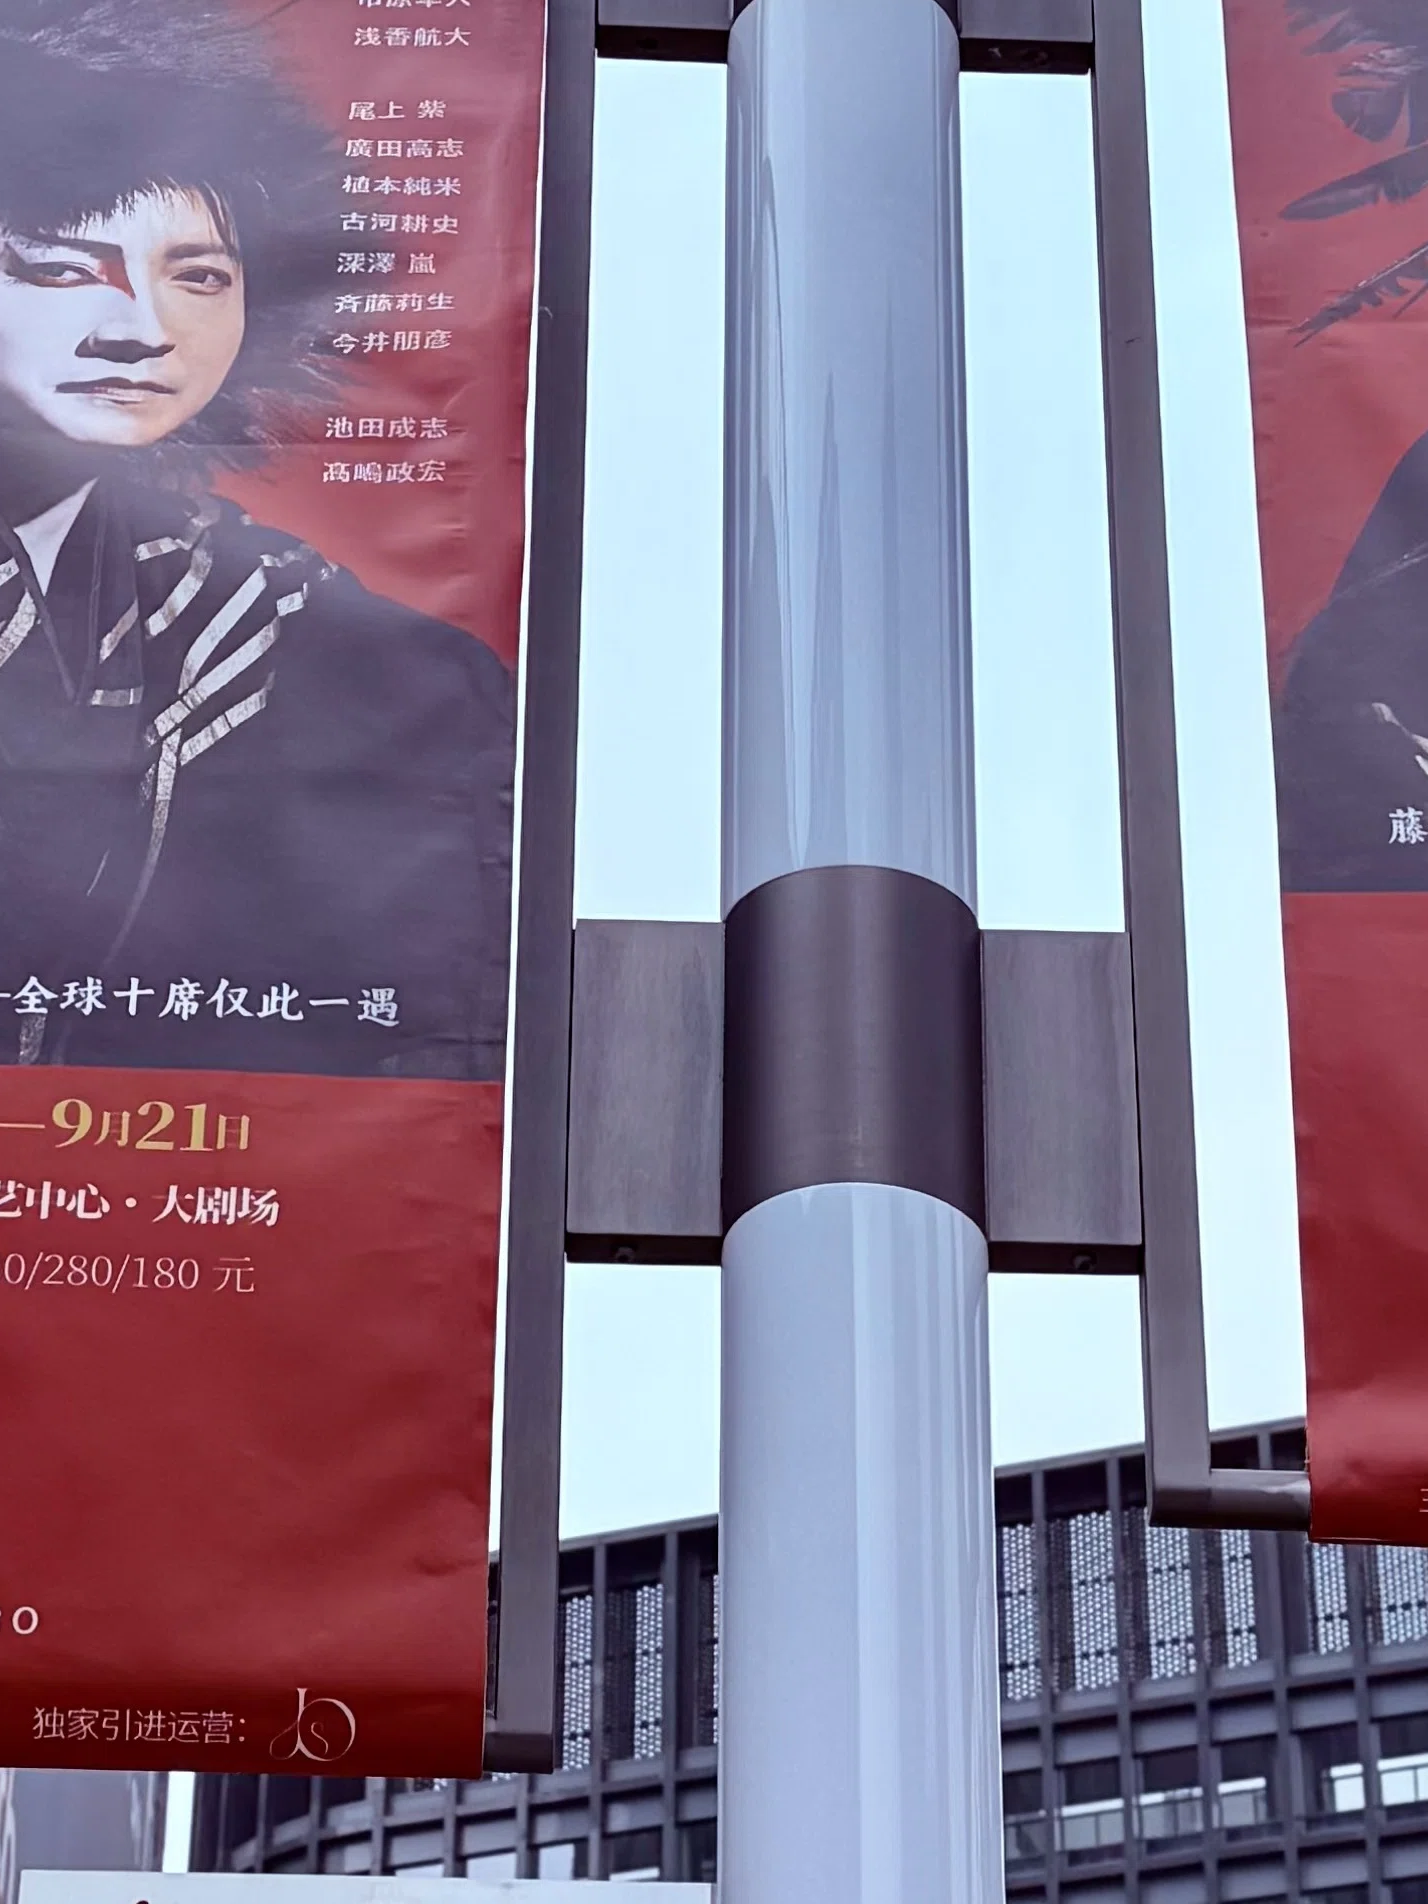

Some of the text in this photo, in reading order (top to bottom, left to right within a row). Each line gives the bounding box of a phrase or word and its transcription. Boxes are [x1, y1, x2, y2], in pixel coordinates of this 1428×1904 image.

[325, 416, 449, 439] 池田成志
[211, 1255, 256, 1293] 元
